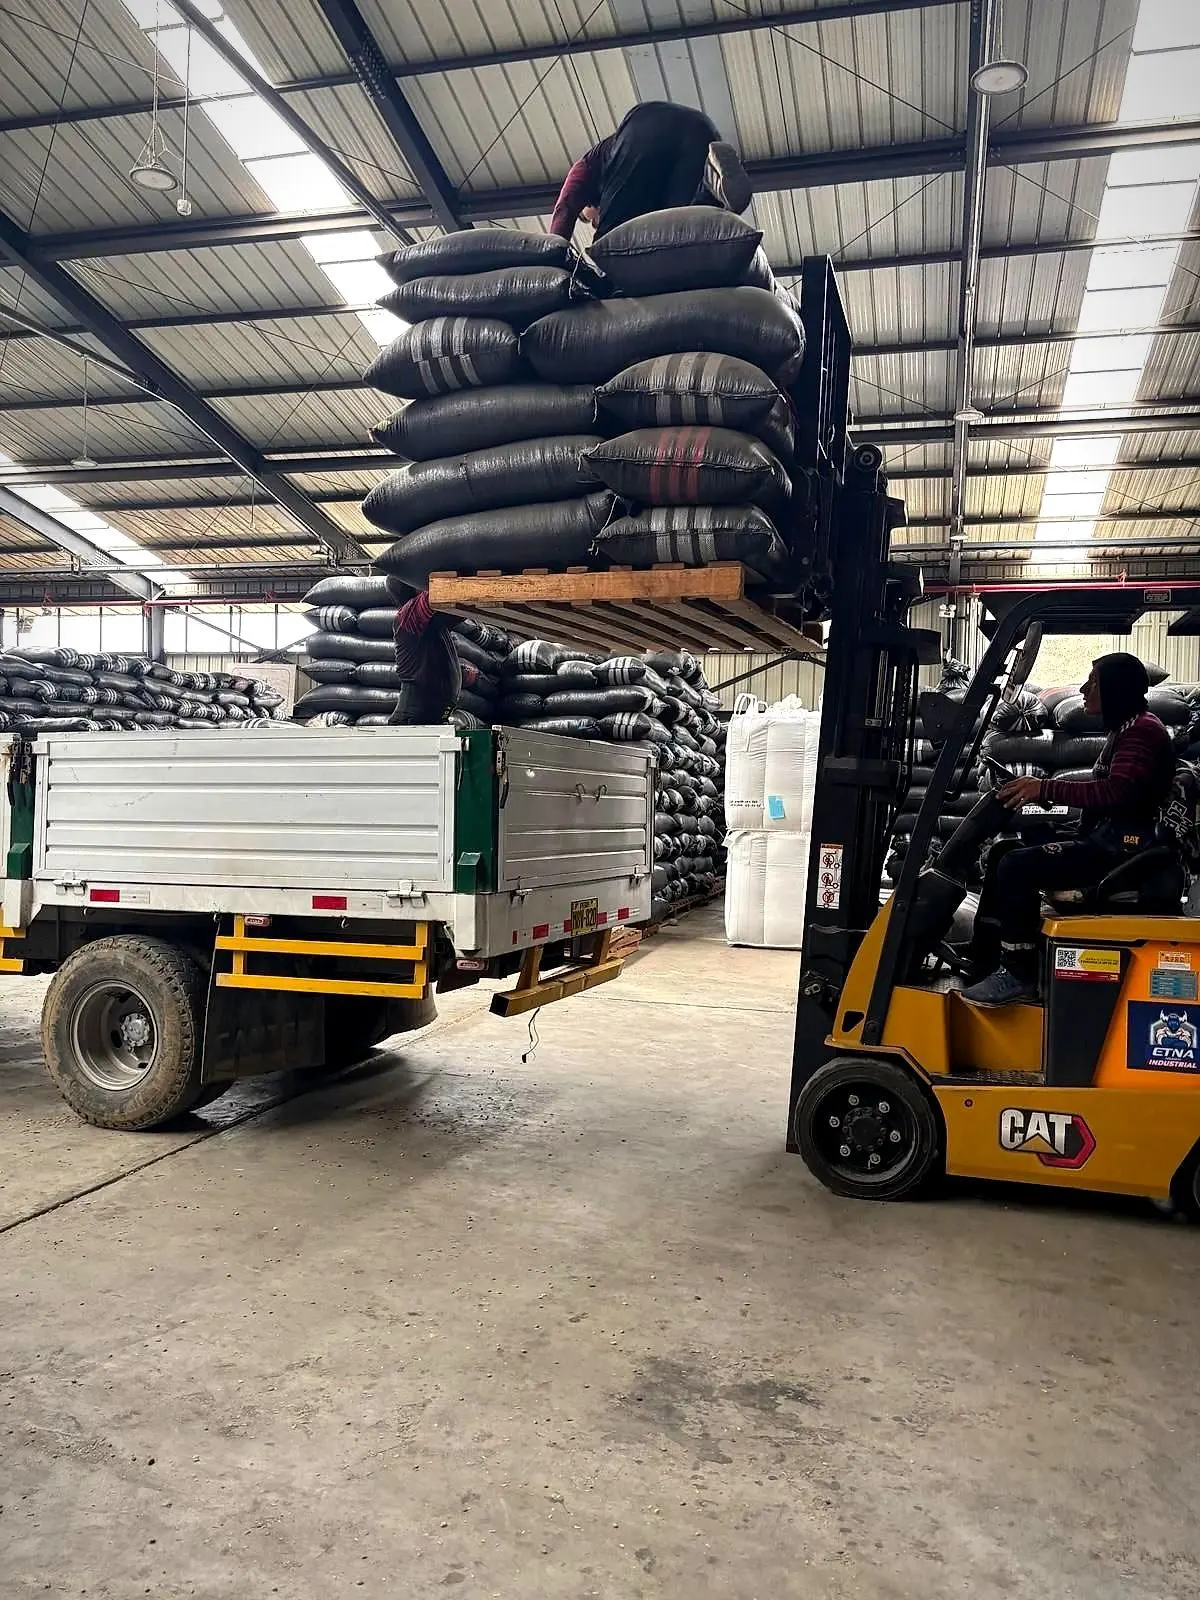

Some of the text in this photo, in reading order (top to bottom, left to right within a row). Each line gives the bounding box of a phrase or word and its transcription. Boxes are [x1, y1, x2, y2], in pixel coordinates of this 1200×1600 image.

[1152, 1047, 1194, 1059] ETNA
[1148, 1059, 1198, 1069] INDUSTRIAL
[1001, 1109, 1072, 1155] CAT
